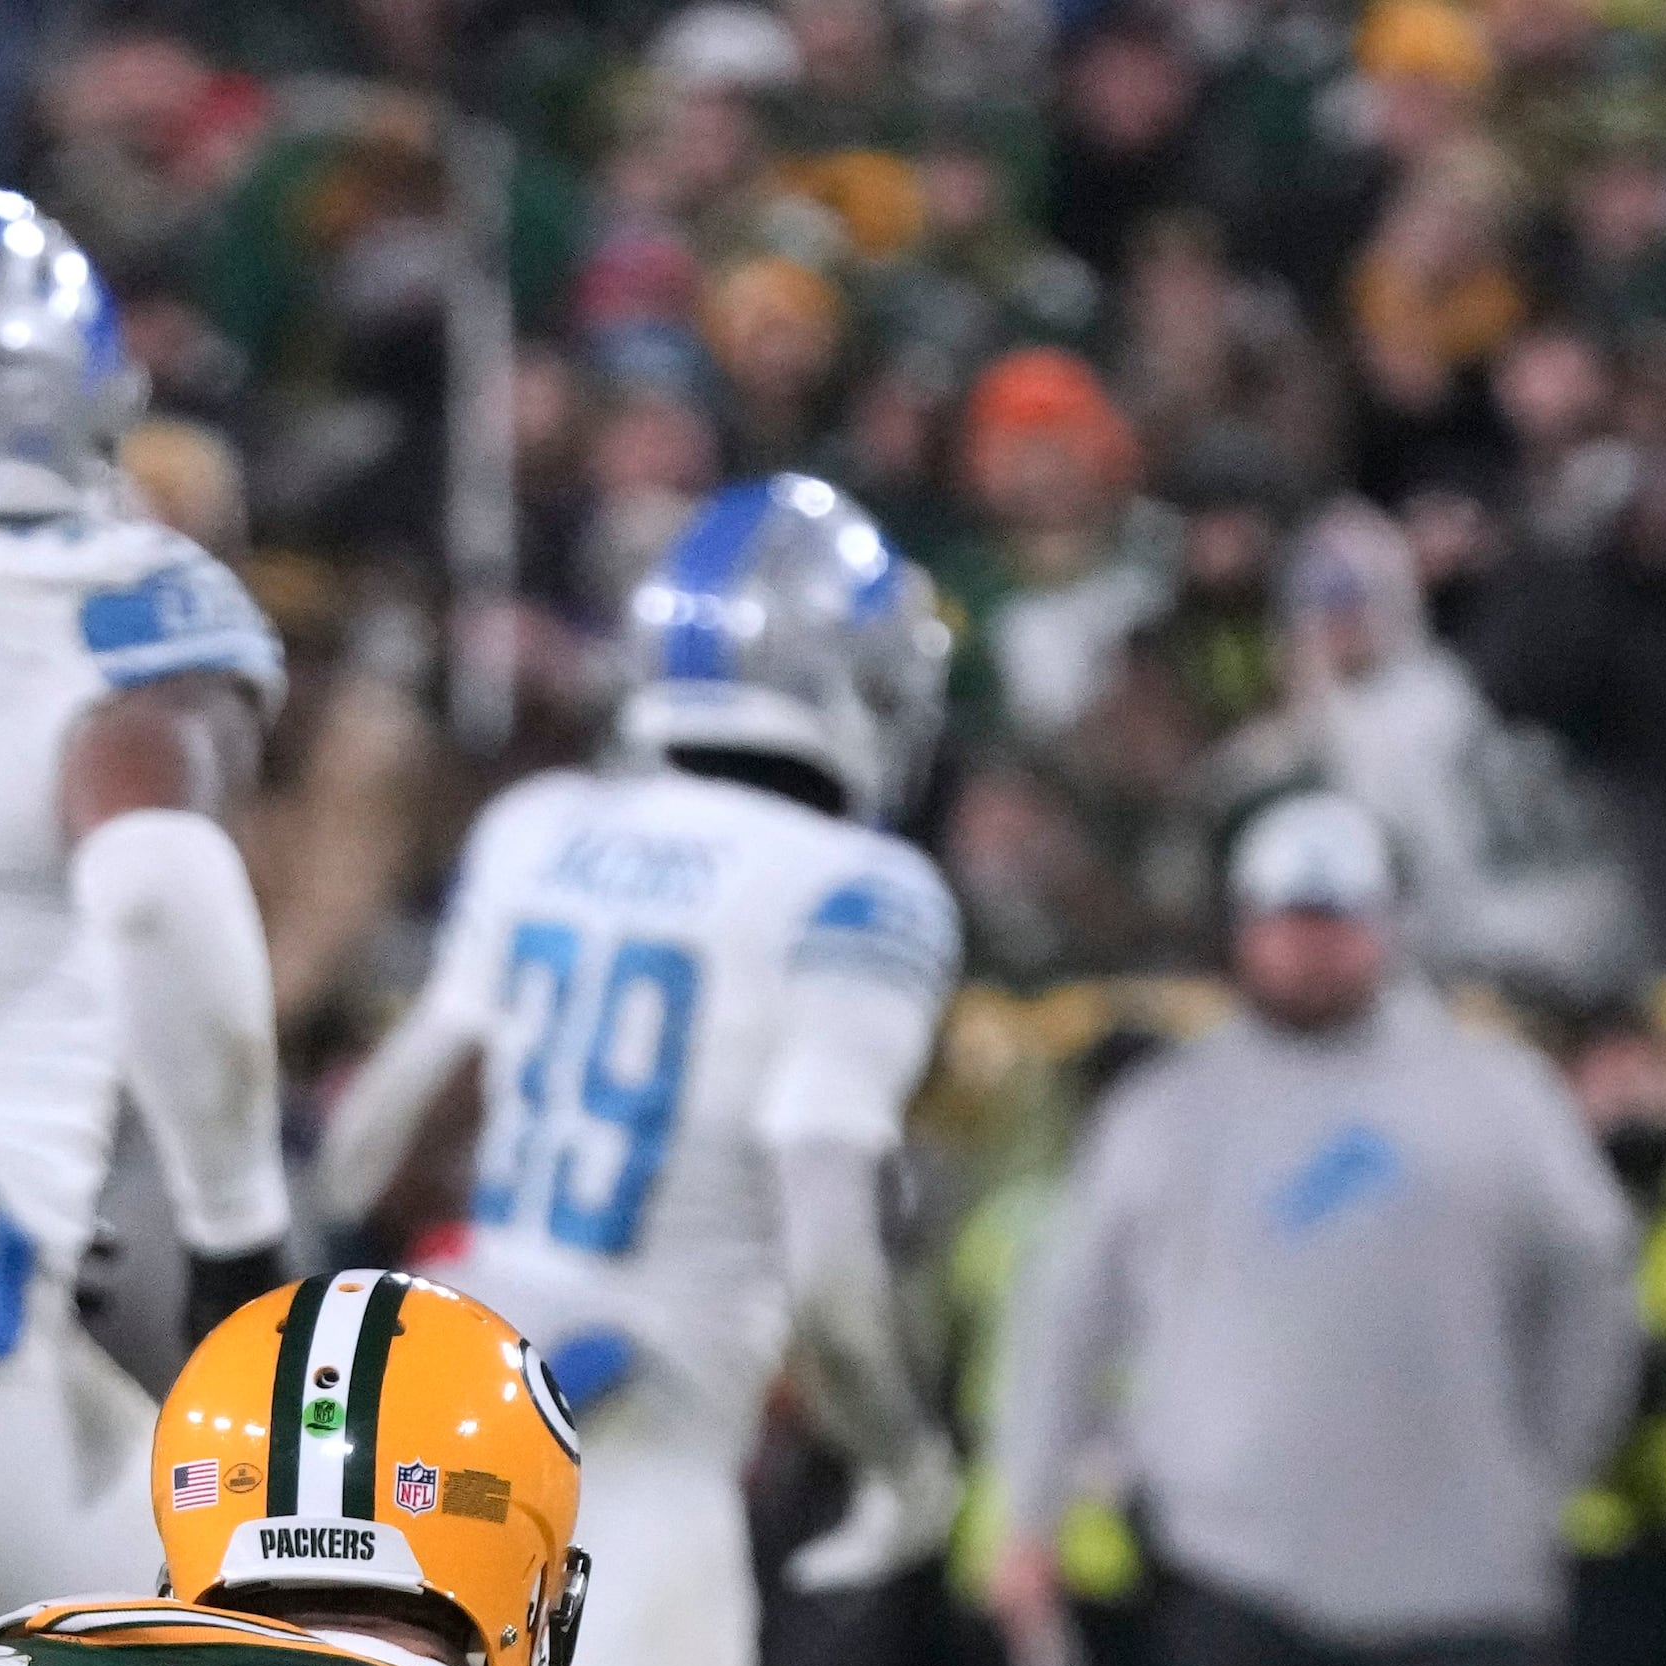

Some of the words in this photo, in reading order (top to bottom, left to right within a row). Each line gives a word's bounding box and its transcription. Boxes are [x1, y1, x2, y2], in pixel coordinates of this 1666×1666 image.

[471, 924, 697, 1250] 39
[400, 1483, 431, 1507] NFL
[260, 1527, 376, 1561] PACKERS
